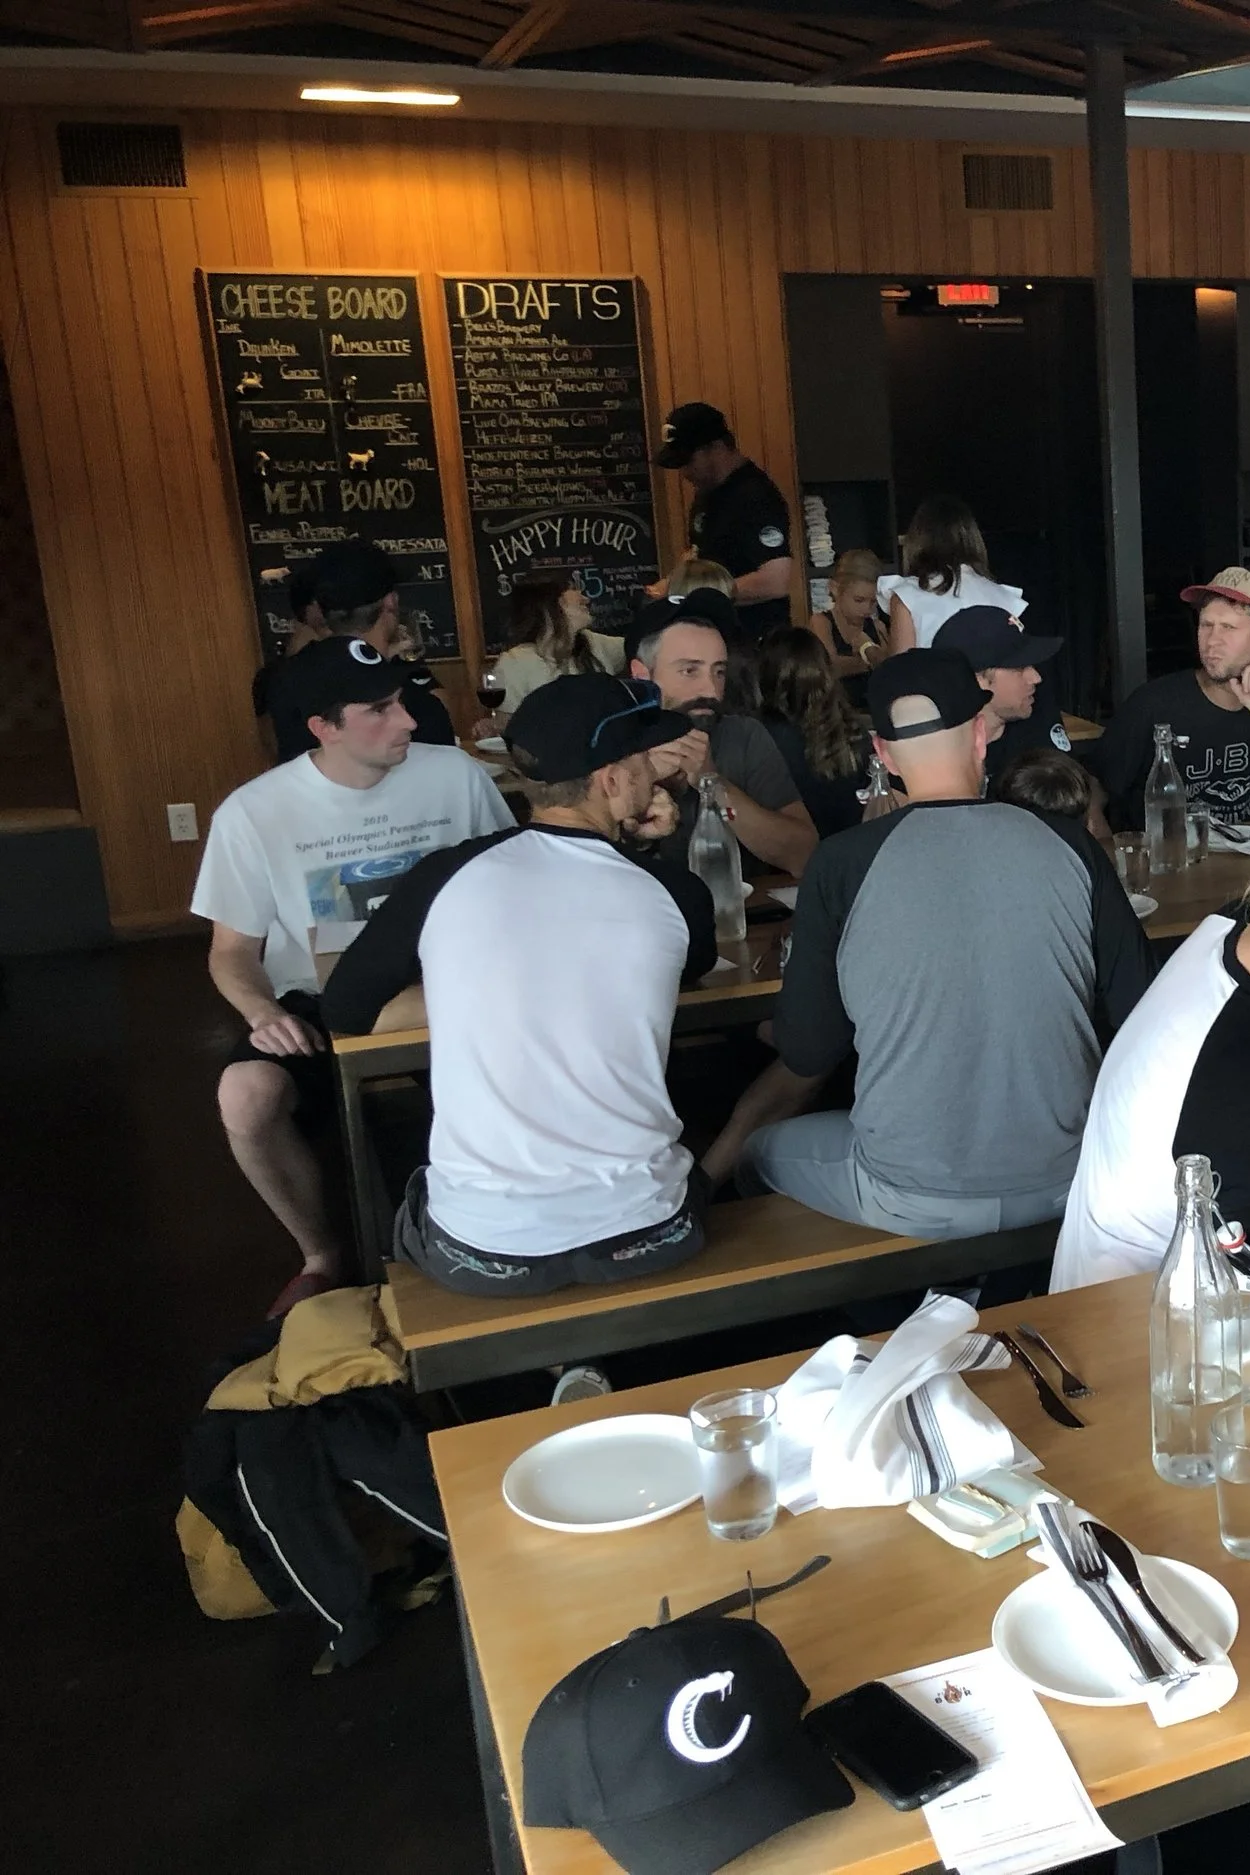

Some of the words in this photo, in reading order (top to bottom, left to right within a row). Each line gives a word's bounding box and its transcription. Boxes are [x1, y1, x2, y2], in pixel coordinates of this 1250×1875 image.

[221, 284, 318, 320] CHEESE
[326, 286, 407, 320] BOARD
[457, 281, 621, 320] DRAFTS
[331, 333, 413, 354] MIMOLETTE
[515, 380, 553, 392] VALLEY
[541, 391, 560, 407] IPA
[263, 480, 327, 515] MEAT
[340, 478, 416, 513] BOARD
[489, 517, 564, 572] HAPPY
[571, 517, 637, 556] HOUR
[295, 835, 335, 853] Special
[337, 829, 387, 846] Olympics
[325, 846, 363, 860] Beaver
[366, 836, 410, 854] Stadium
